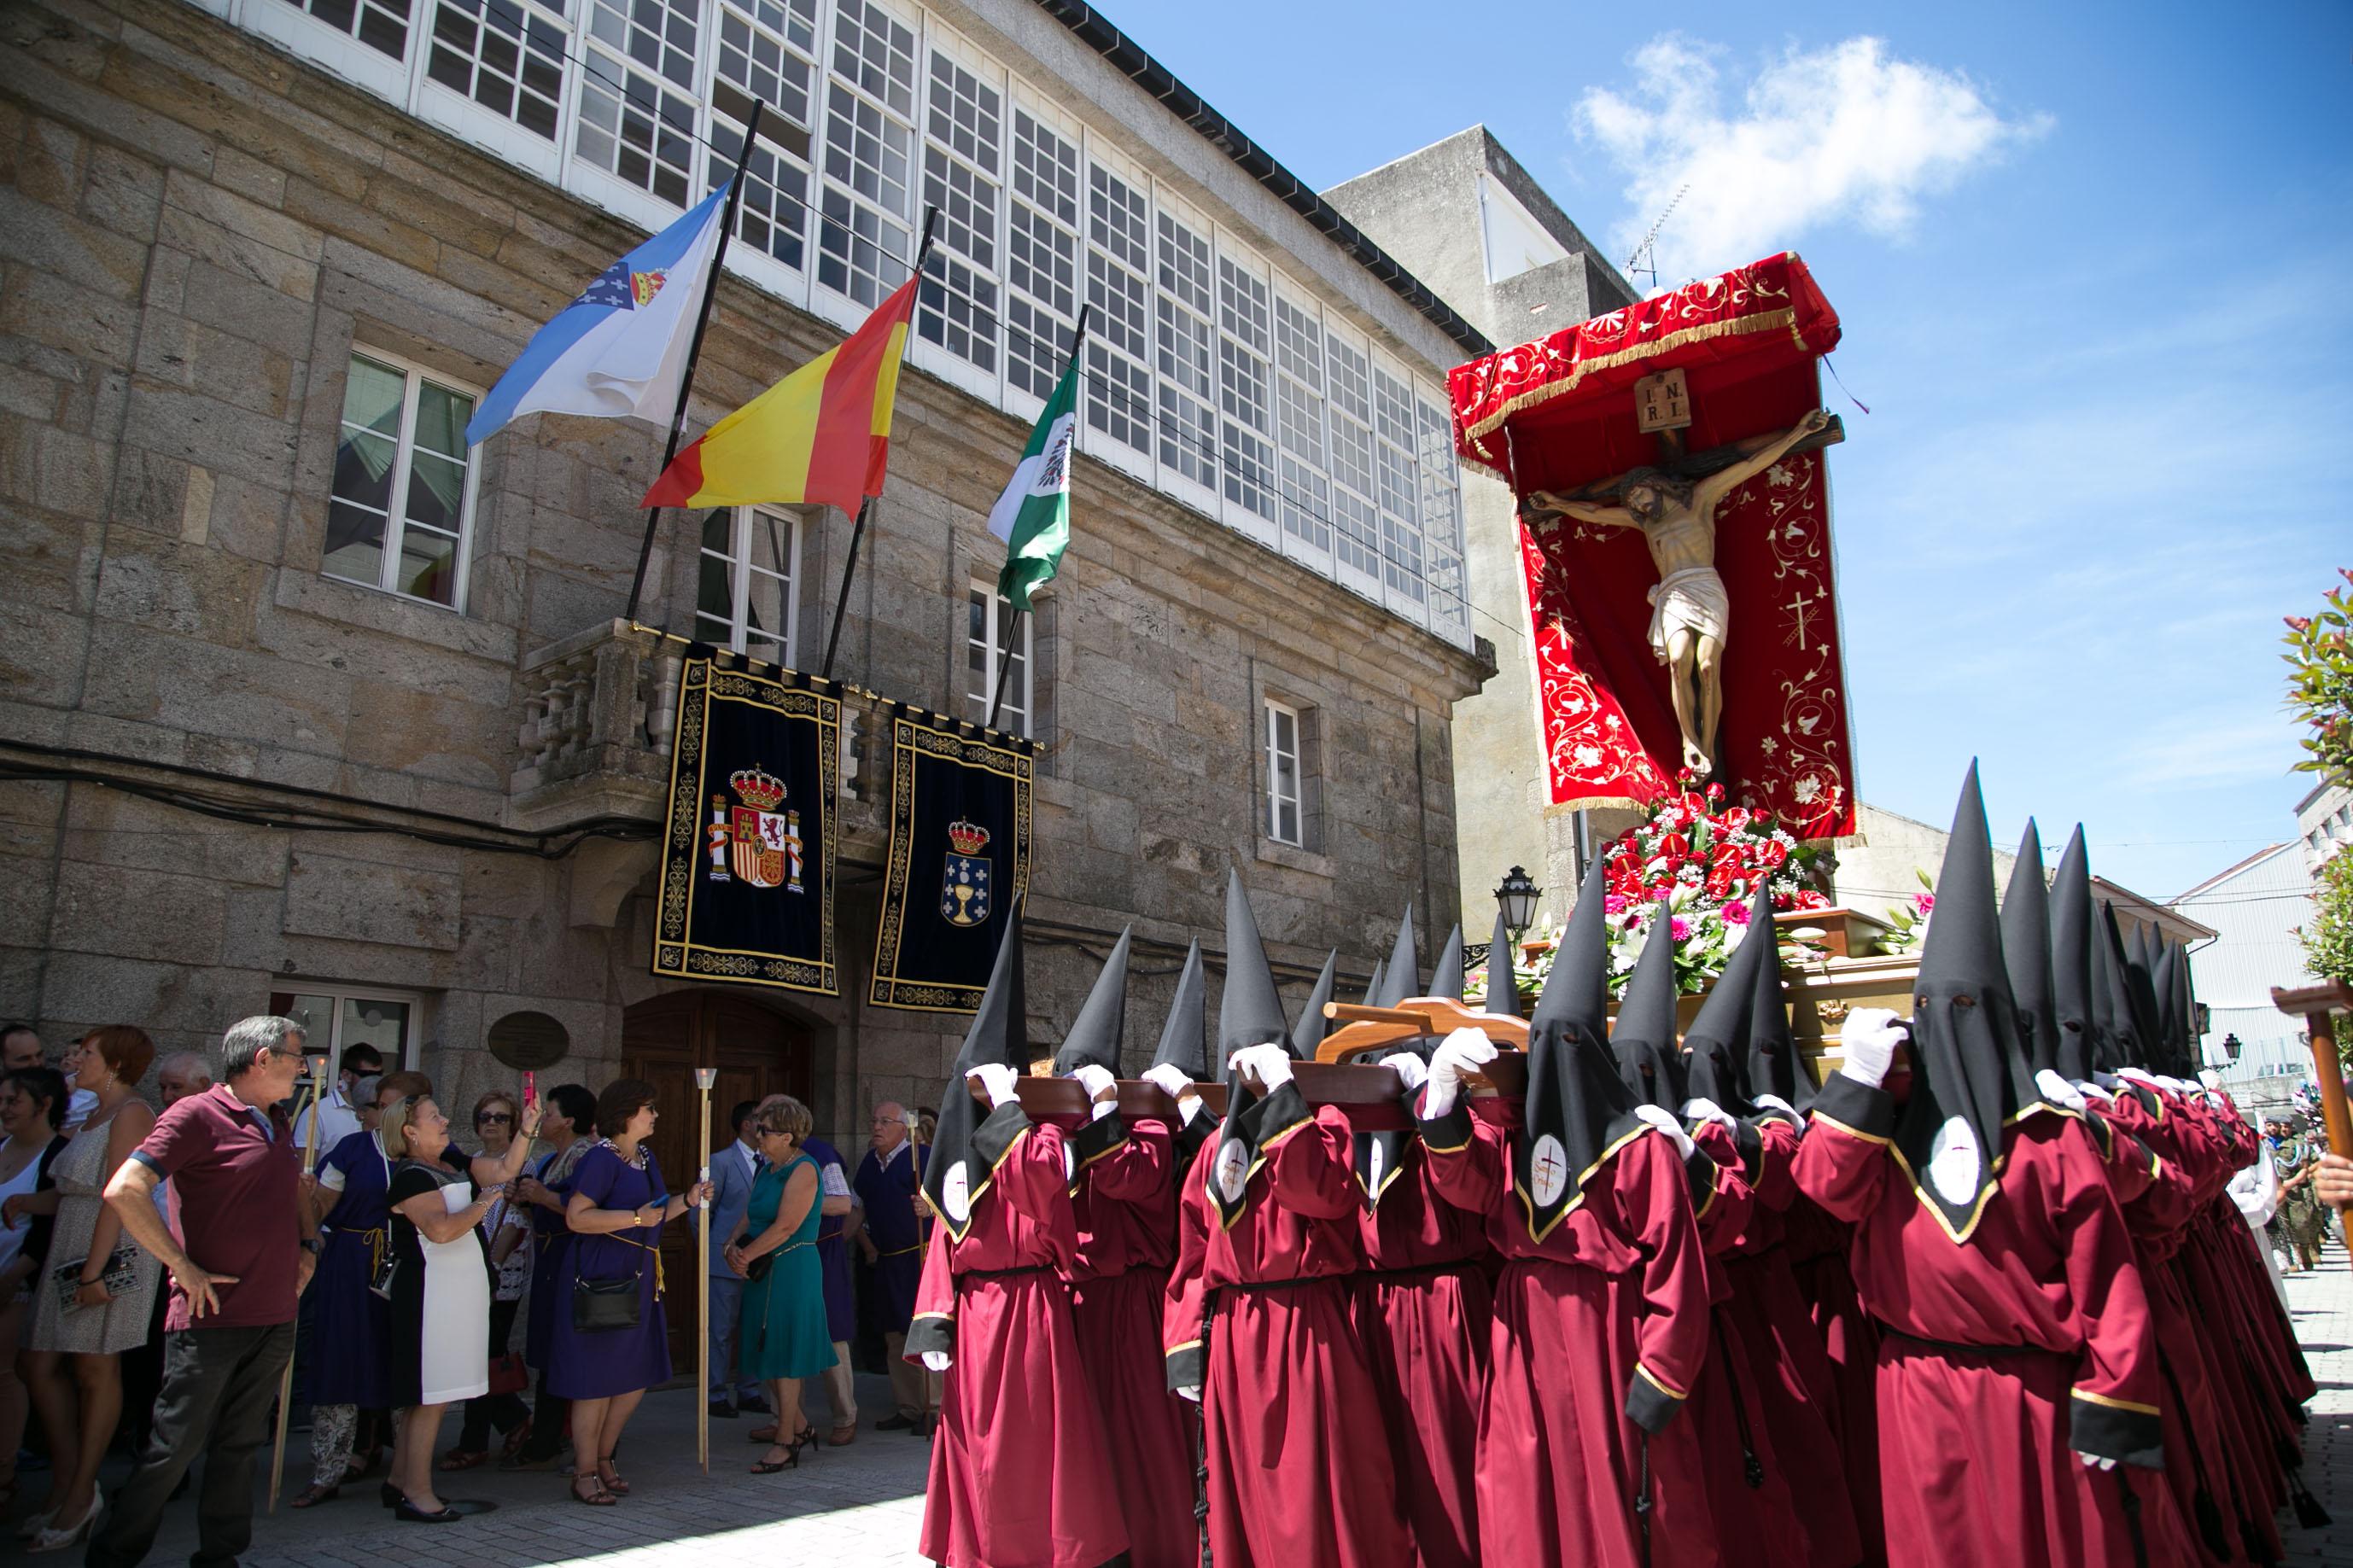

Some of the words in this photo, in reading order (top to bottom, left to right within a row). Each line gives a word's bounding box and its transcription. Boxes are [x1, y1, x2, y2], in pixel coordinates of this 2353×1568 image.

[1646, 389, 1656, 403] I.
[1666, 382, 1683, 399] N.
[1648, 406, 1662, 421] R.
[1671, 402, 1682, 417] I.
